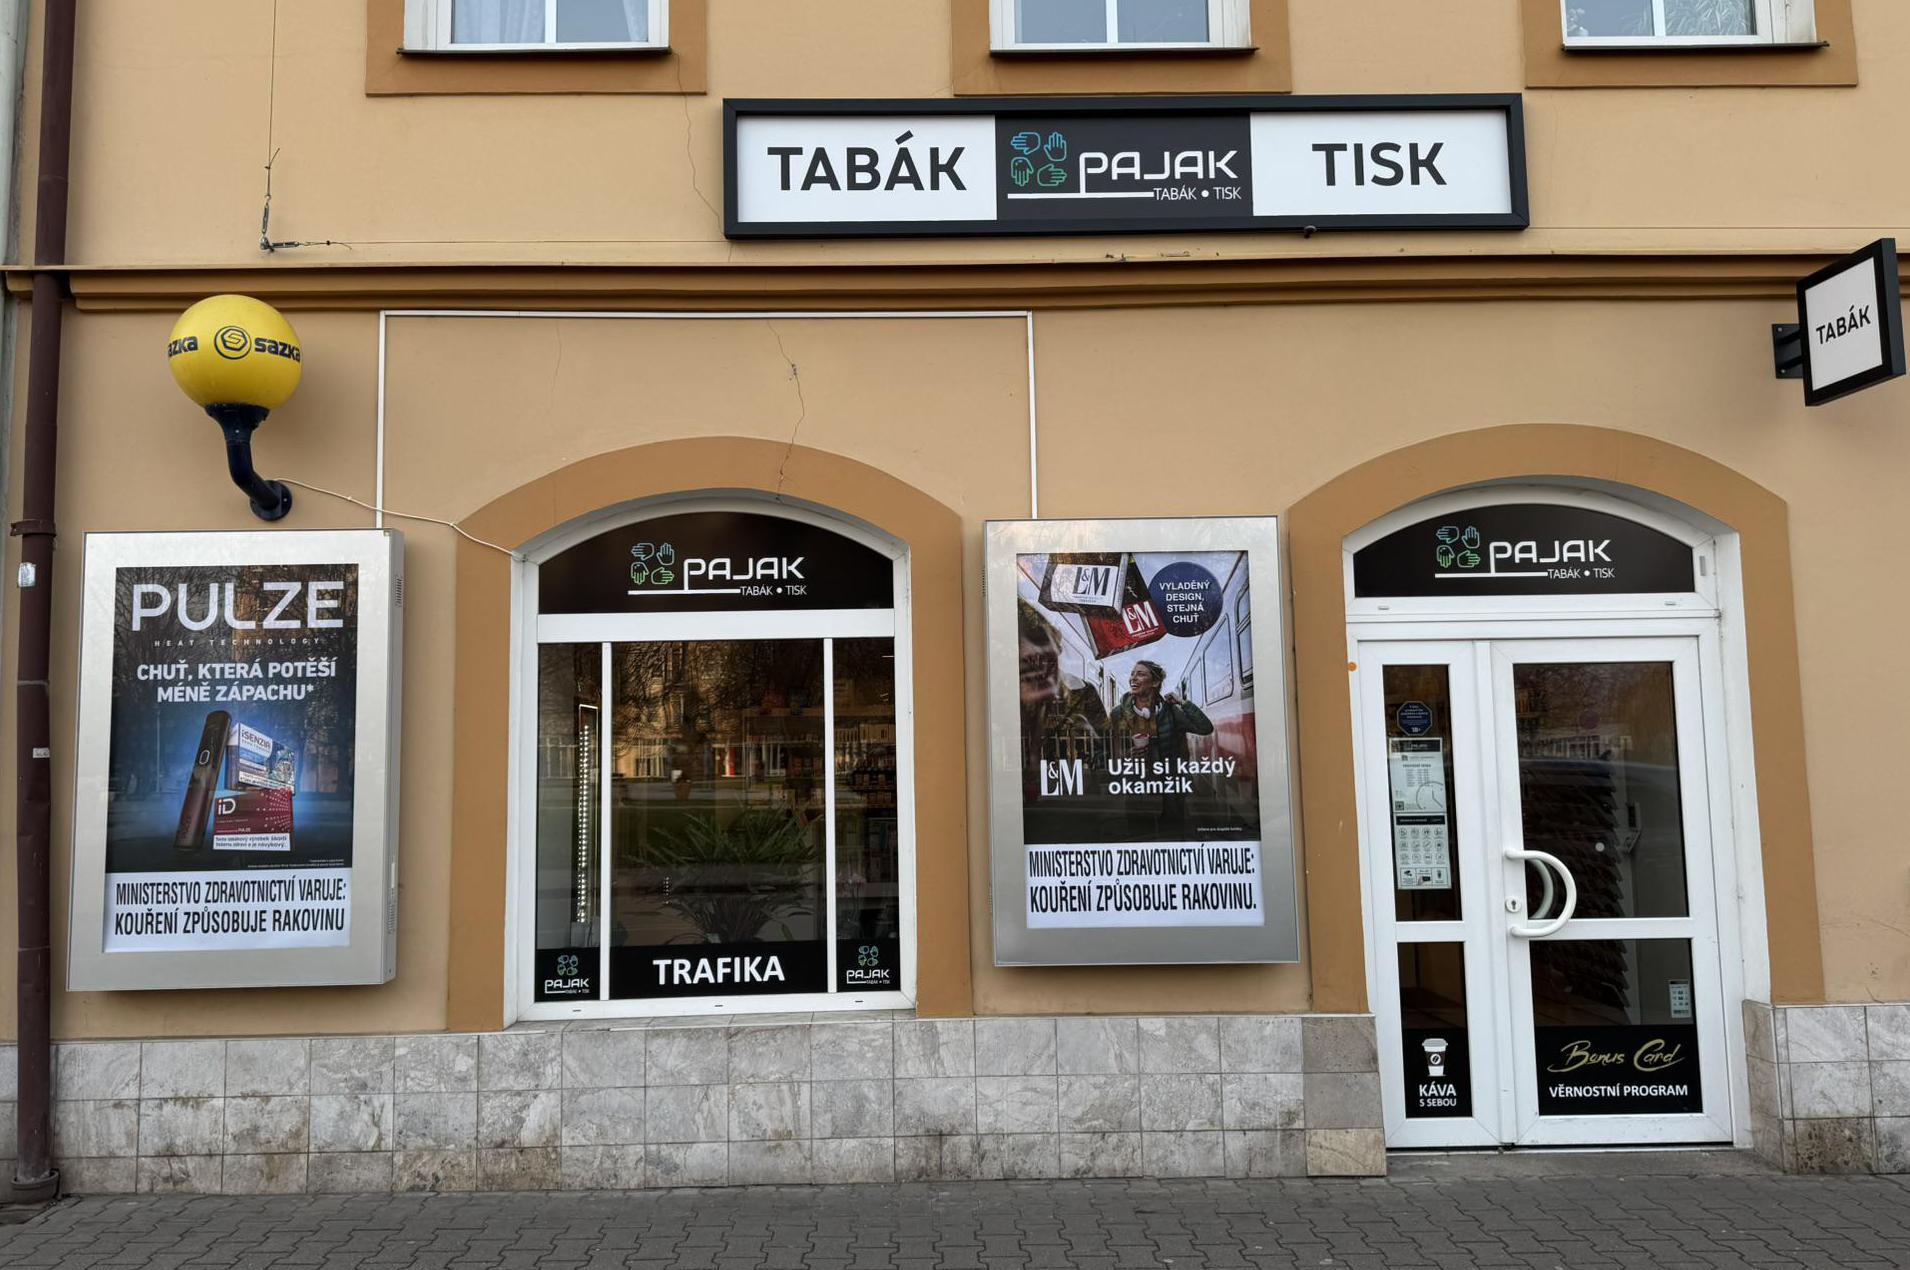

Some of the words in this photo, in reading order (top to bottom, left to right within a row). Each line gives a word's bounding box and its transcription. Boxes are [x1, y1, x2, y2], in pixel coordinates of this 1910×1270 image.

[767, 130, 966, 192] TABÁK
[1079, 150, 1238, 192] PAJAK
[1312, 142, 1447, 187] TISK
[1154, 185, 1197, 200] TABÁK
[1213, 186, 1242, 199] TISK
[1816, 305, 1871, 345] TABÁK
[1489, 539, 1612, 572] PAJAK
[683, 557, 805, 590] PAJAK
[1073, 567, 1111, 596] L&M
[1159, 580, 1211, 591] VYLADĚNÝ
[1547, 567, 1581, 579] TABÁK
[1593, 568, 1615, 578] TISK
[740, 584, 773, 596] TABÁK
[785, 585, 807, 595] TISK
[1165, 592, 1205, 602] DESIGN,
[132, 580, 344, 631] PULZE
[1122, 601, 1159, 634] L&M
[1166, 602, 1204, 613] STEJNÁ
[1173, 612, 1200, 623] CHUŤ
[154, 639, 195, 647] HEAT
[210, 637, 320, 647] TECHNOLOGY
[137, 660, 193, 681] CHUŤ,
[198, 658, 263, 679] KTERÁ
[268, 656, 339, 678] POTĚŠÍ
[157, 677, 210, 702] MÉNĚ
[1040, 759, 1084, 796] L&M
[1108, 759, 1146, 778] Užij
[1152, 758, 1170, 775] si
[1177, 756, 1236, 778] každý
[1108, 777, 1193, 794] okamžik
[1029, 849, 1113, 877] MINISTERSTVO
[1116, 843, 1205, 876] ZDRAVOTNICTVÍ
[1207, 848, 1255, 875] VARUJE:
[116, 882, 201, 905] MINISTERSTVO
[204, 875, 298, 904] ZDRAVOTNICTVÍ
[298, 878, 347, 901] VARUJE:
[1030, 880, 1091, 913] KOUŘENÍ
[1096, 878, 1177, 912] ZPŮSOBUJE
[1182, 883, 1257, 910] RAKOVINU.
[115, 908, 179, 935] KOUŘENÍ
[183, 906, 267, 934] ZPŮSOBUJE
[272, 908, 345, 932] RAKOVINU
[652, 955, 786, 985] TRAFIKA
[846, 969, 890, 983] PAJAK
[544, 978, 589, 991] PAJAK
[1547, 1040, 1625, 1073] Bonus
[1633, 1039, 1685, 1072] Card
[1419, 1081, 1457, 1097] KÁVA
[1419, 1099, 1425, 1107] S
[1427, 1098, 1457, 1107] SEBOU
[1549, 1083, 1621, 1098] VĚRNOSTNÍ
[1623, 1084, 1688, 1097] PROGRAM
